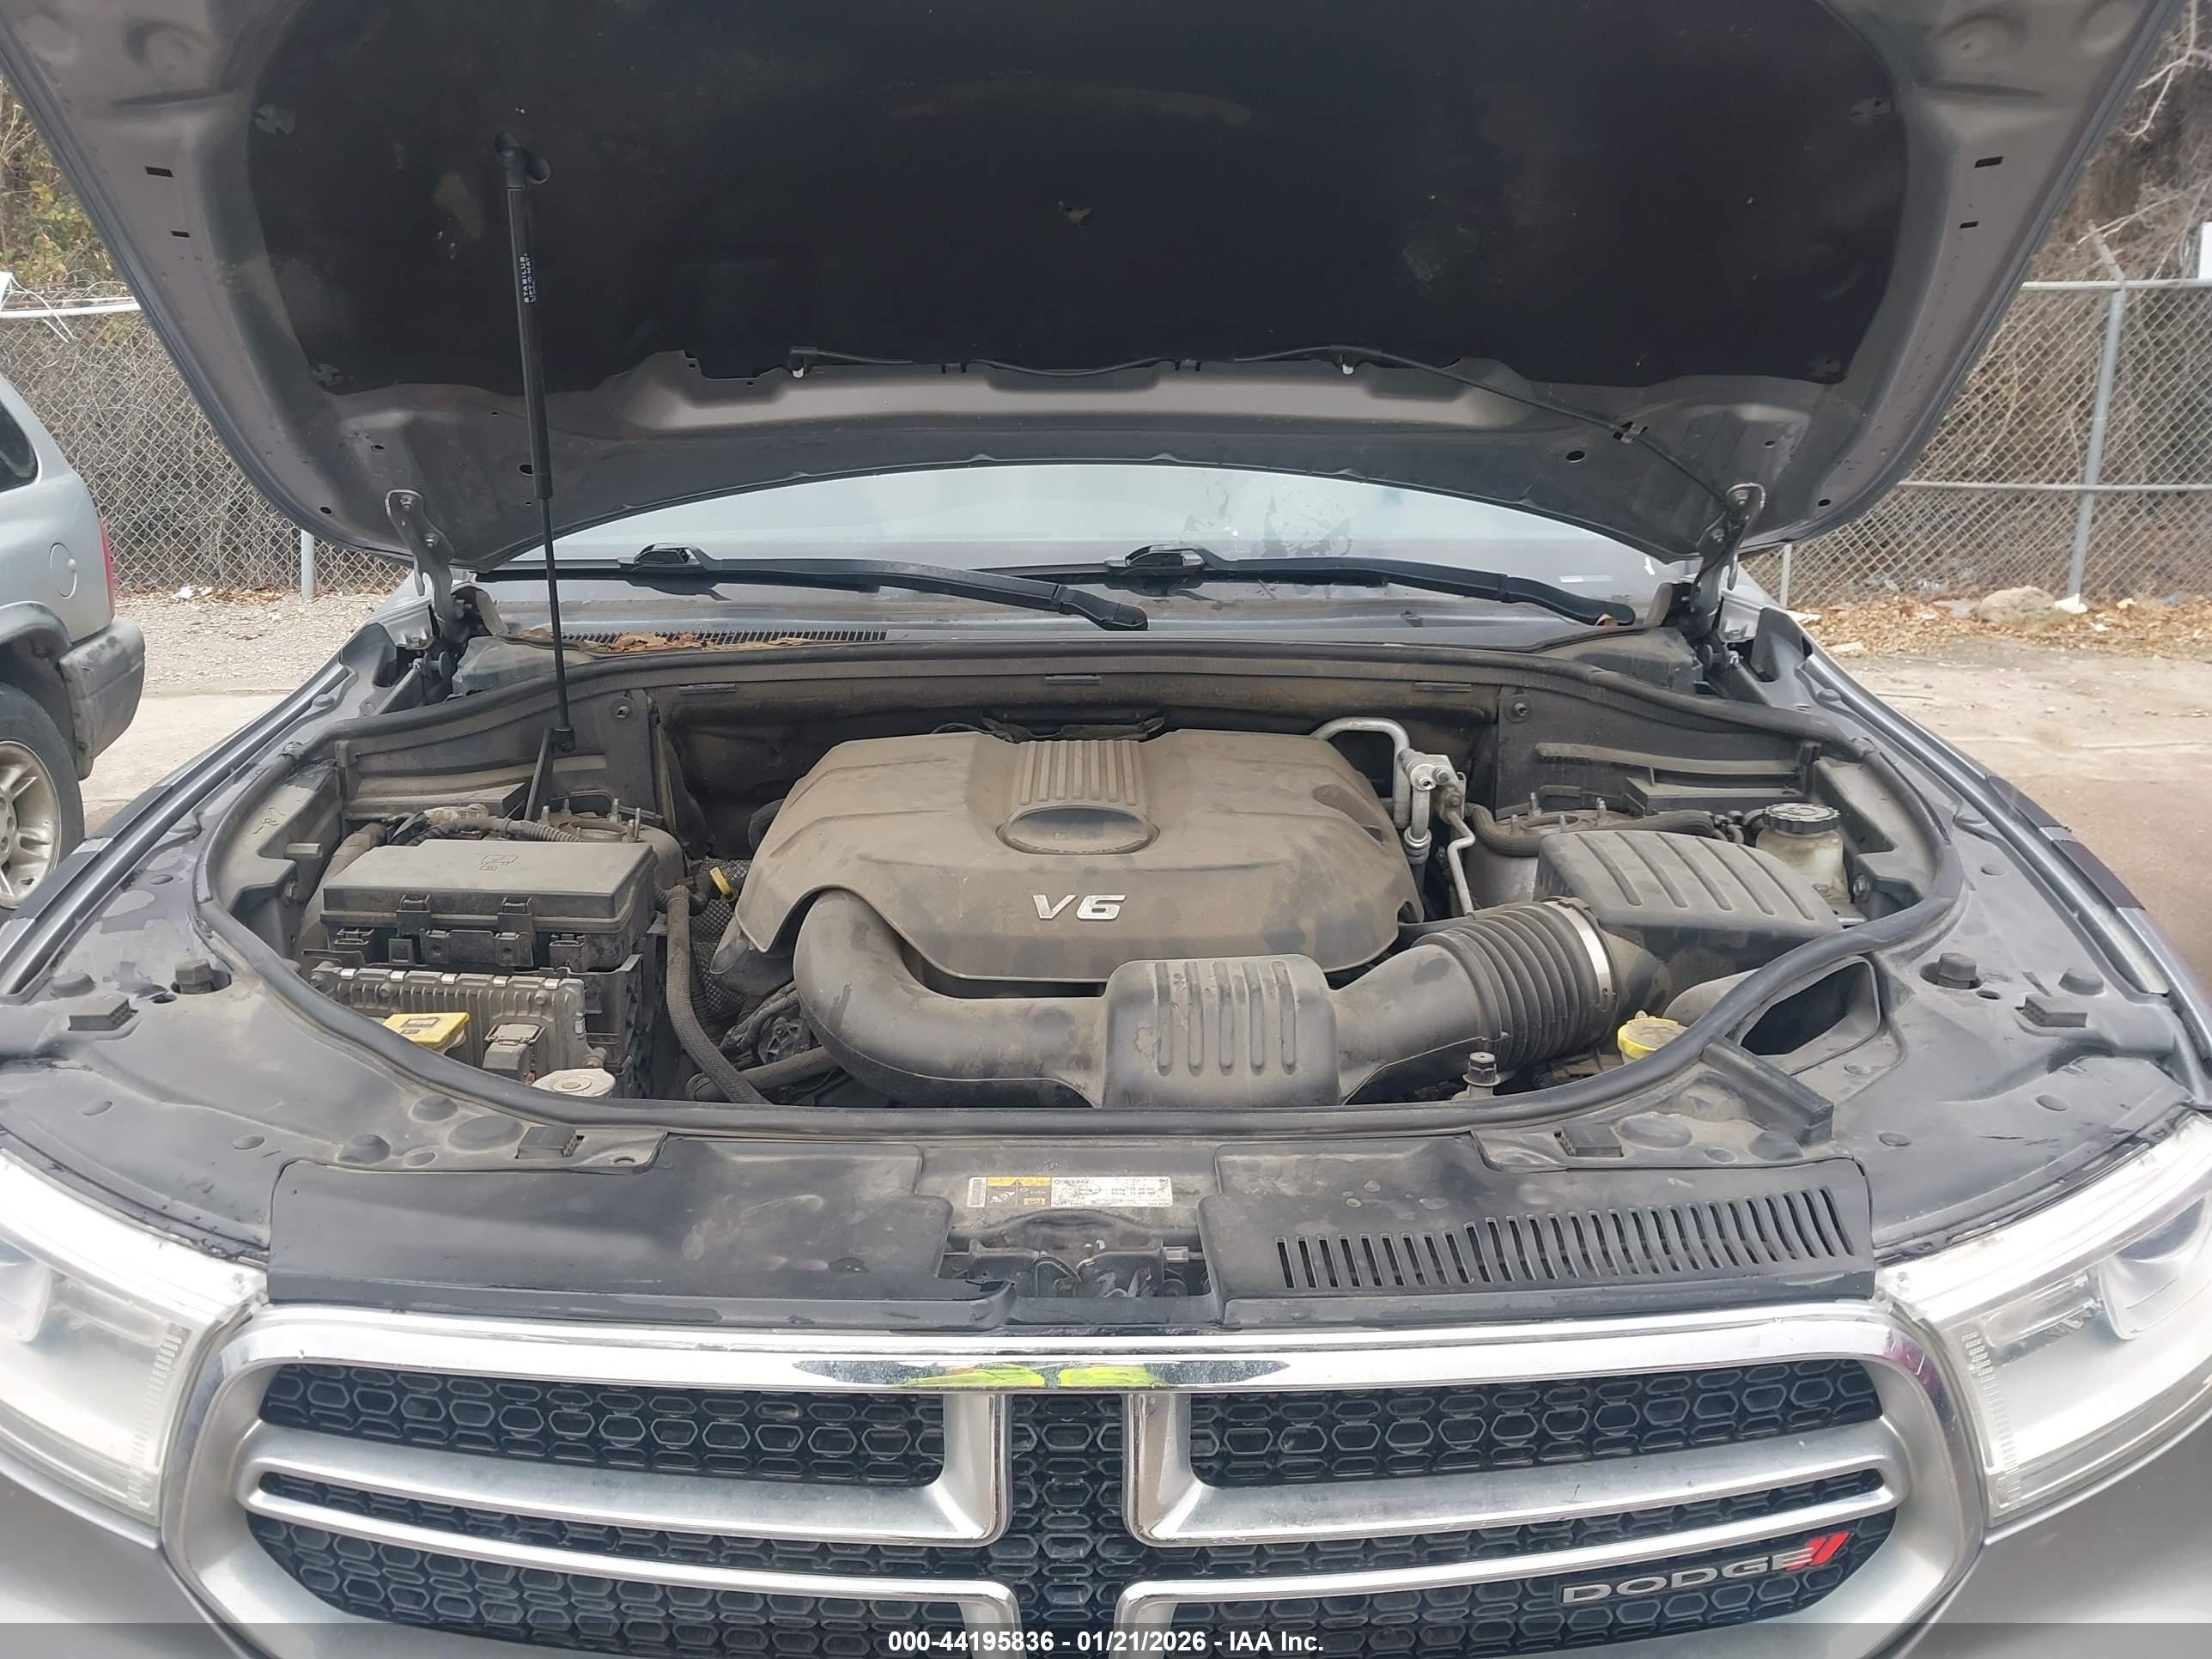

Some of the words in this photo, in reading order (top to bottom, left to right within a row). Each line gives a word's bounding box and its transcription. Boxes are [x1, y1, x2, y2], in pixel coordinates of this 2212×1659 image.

[520, 256, 529, 303] STABILUS
[1032, 894, 1127, 921] V6
[1562, 1547, 1814, 1604] DODGE
